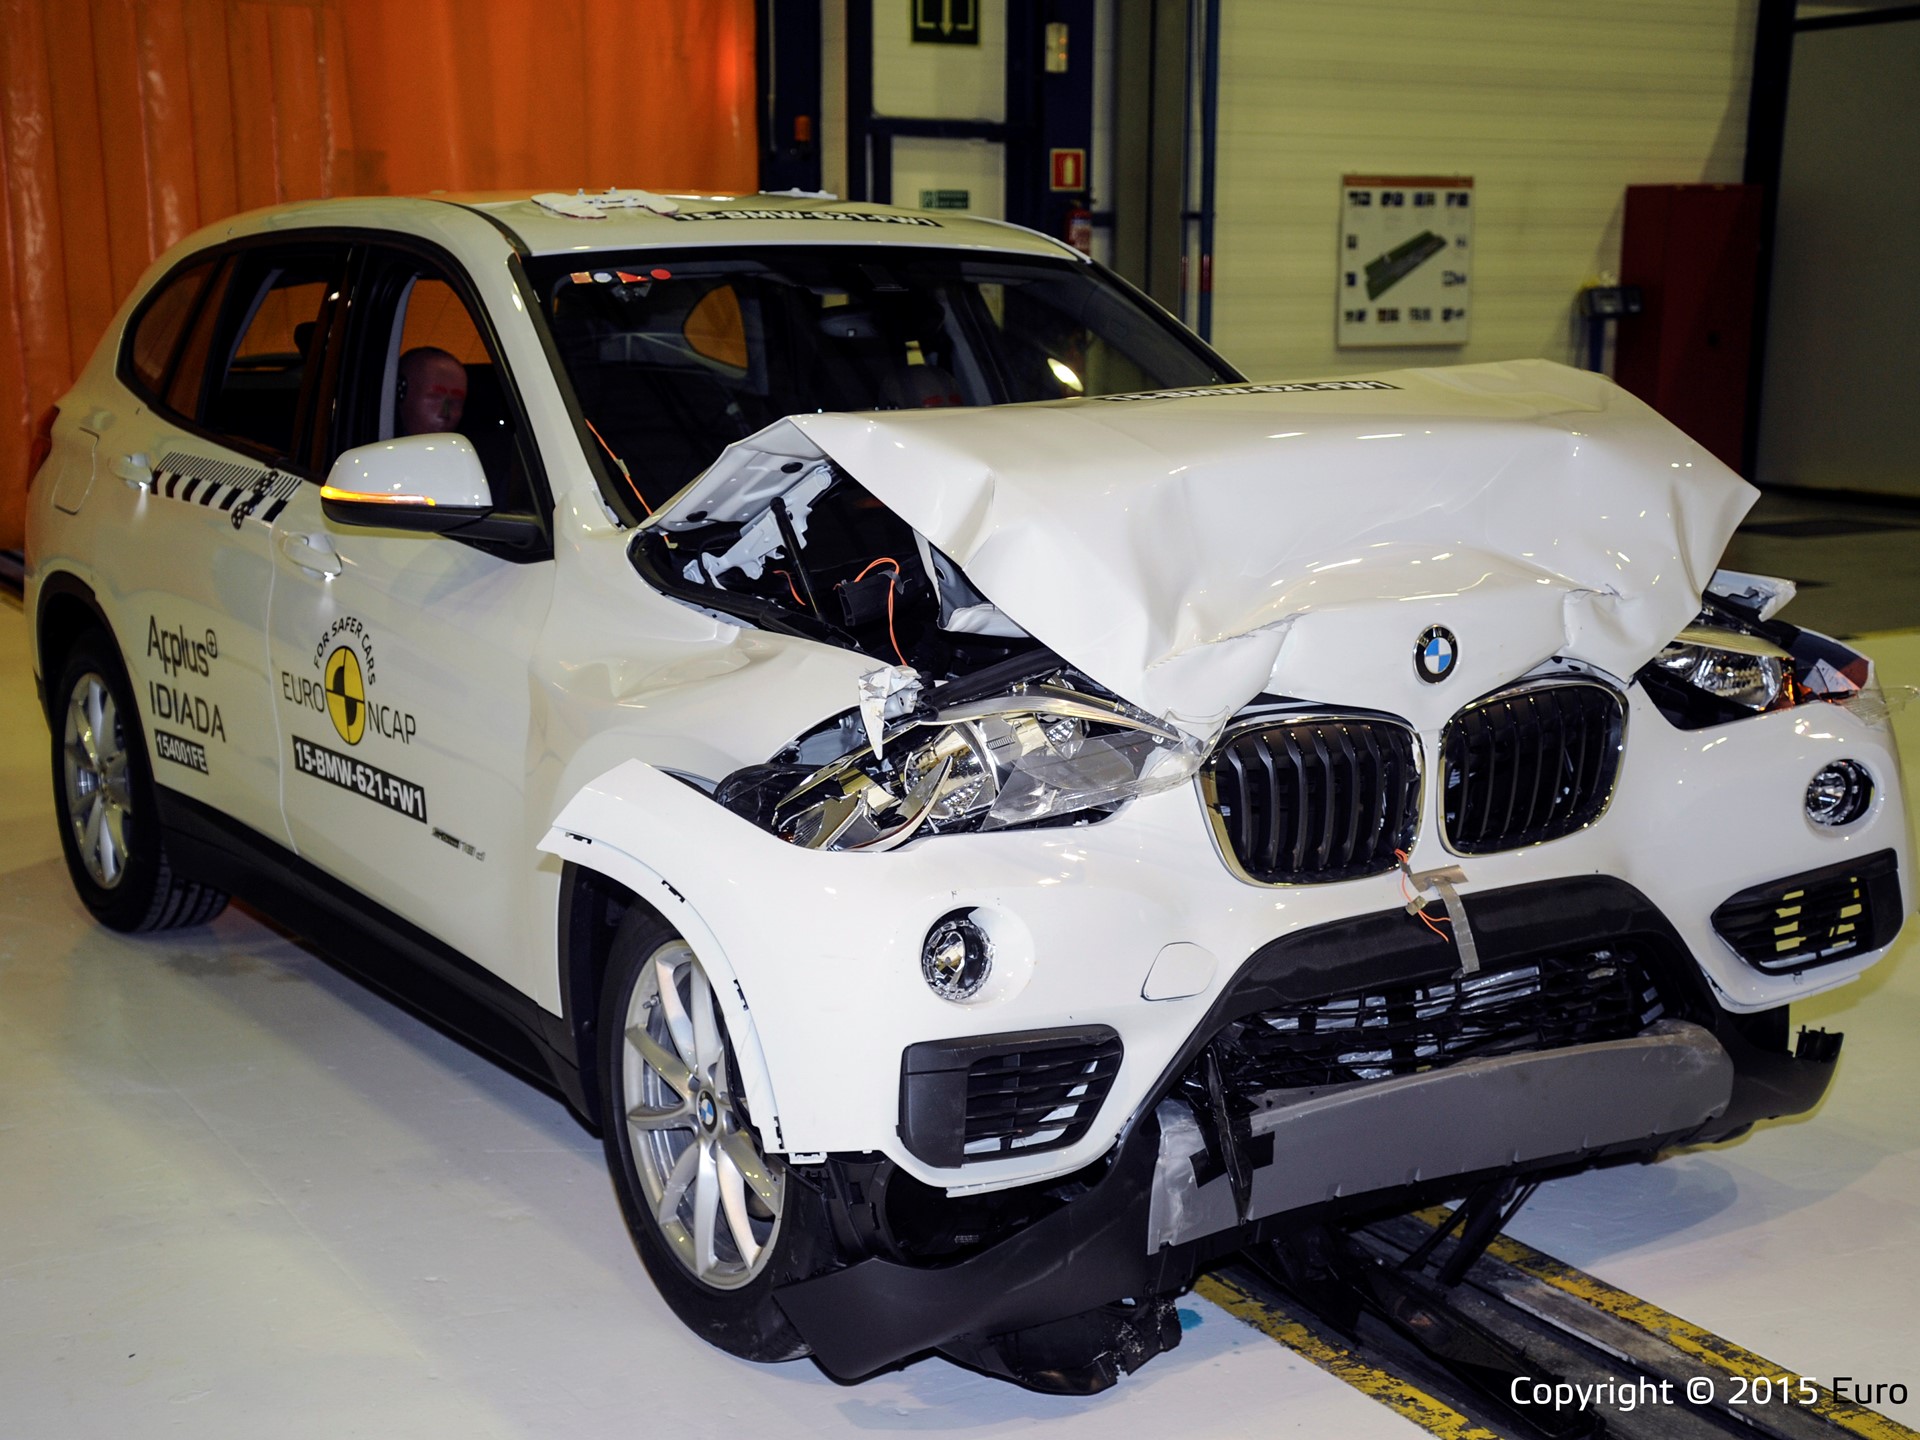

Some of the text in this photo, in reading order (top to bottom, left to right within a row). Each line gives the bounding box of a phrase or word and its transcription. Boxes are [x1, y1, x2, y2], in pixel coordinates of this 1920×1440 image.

[675, 211, 936, 226] 15-BMW-621-FW1
[313, 616, 376, 686] FOR SAFER CARS
[149, 681, 226, 743] IDIADA
[282, 671, 416, 745] EURO NCAP
[295, 741, 424, 819] 15-BMW-621-FW1
